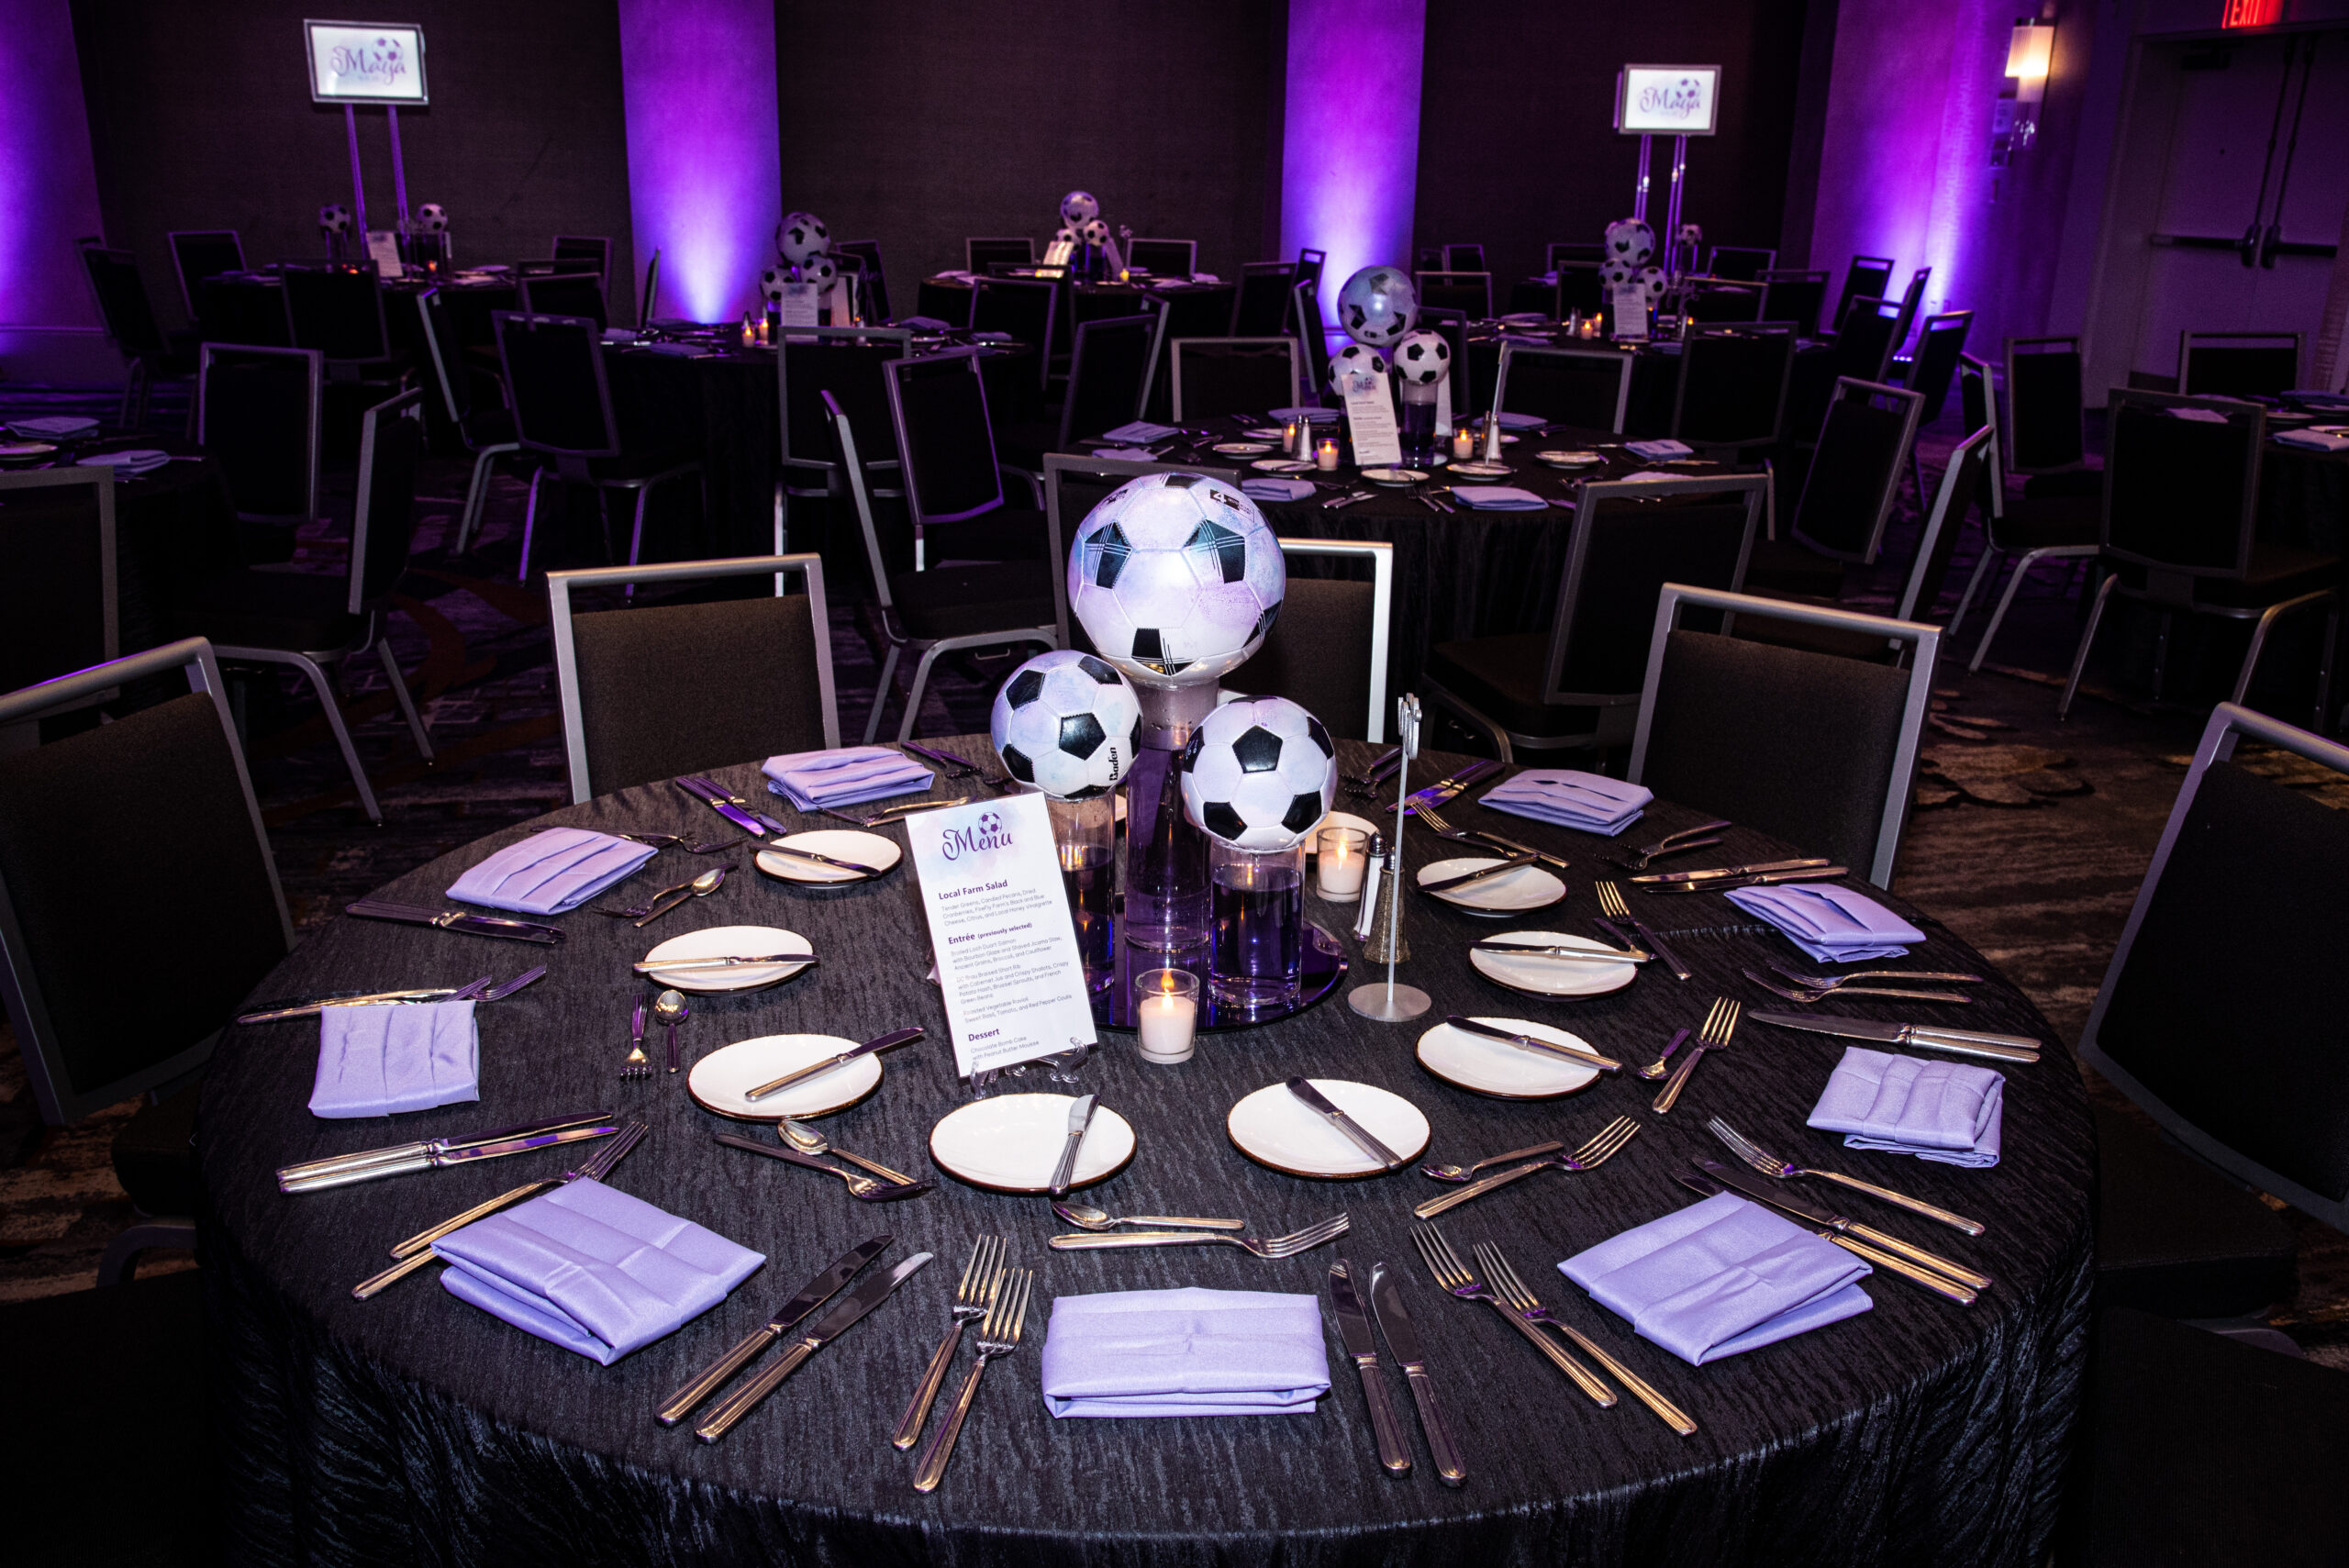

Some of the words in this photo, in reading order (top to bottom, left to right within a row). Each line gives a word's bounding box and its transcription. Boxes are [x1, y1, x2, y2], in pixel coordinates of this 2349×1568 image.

[1108, 747, 1119, 781] Baden
[941, 826, 1014, 861] Menu
[939, 889, 961, 899] Local
[963, 886, 984, 895] Farm
[985, 880, 1008, 891] Salad
[949, 933, 975, 944] Entrée
[978, 929, 1008, 939] (previously
[1009, 922, 1032, 931] selected)
[968, 1029, 1000, 1041] Dessert
